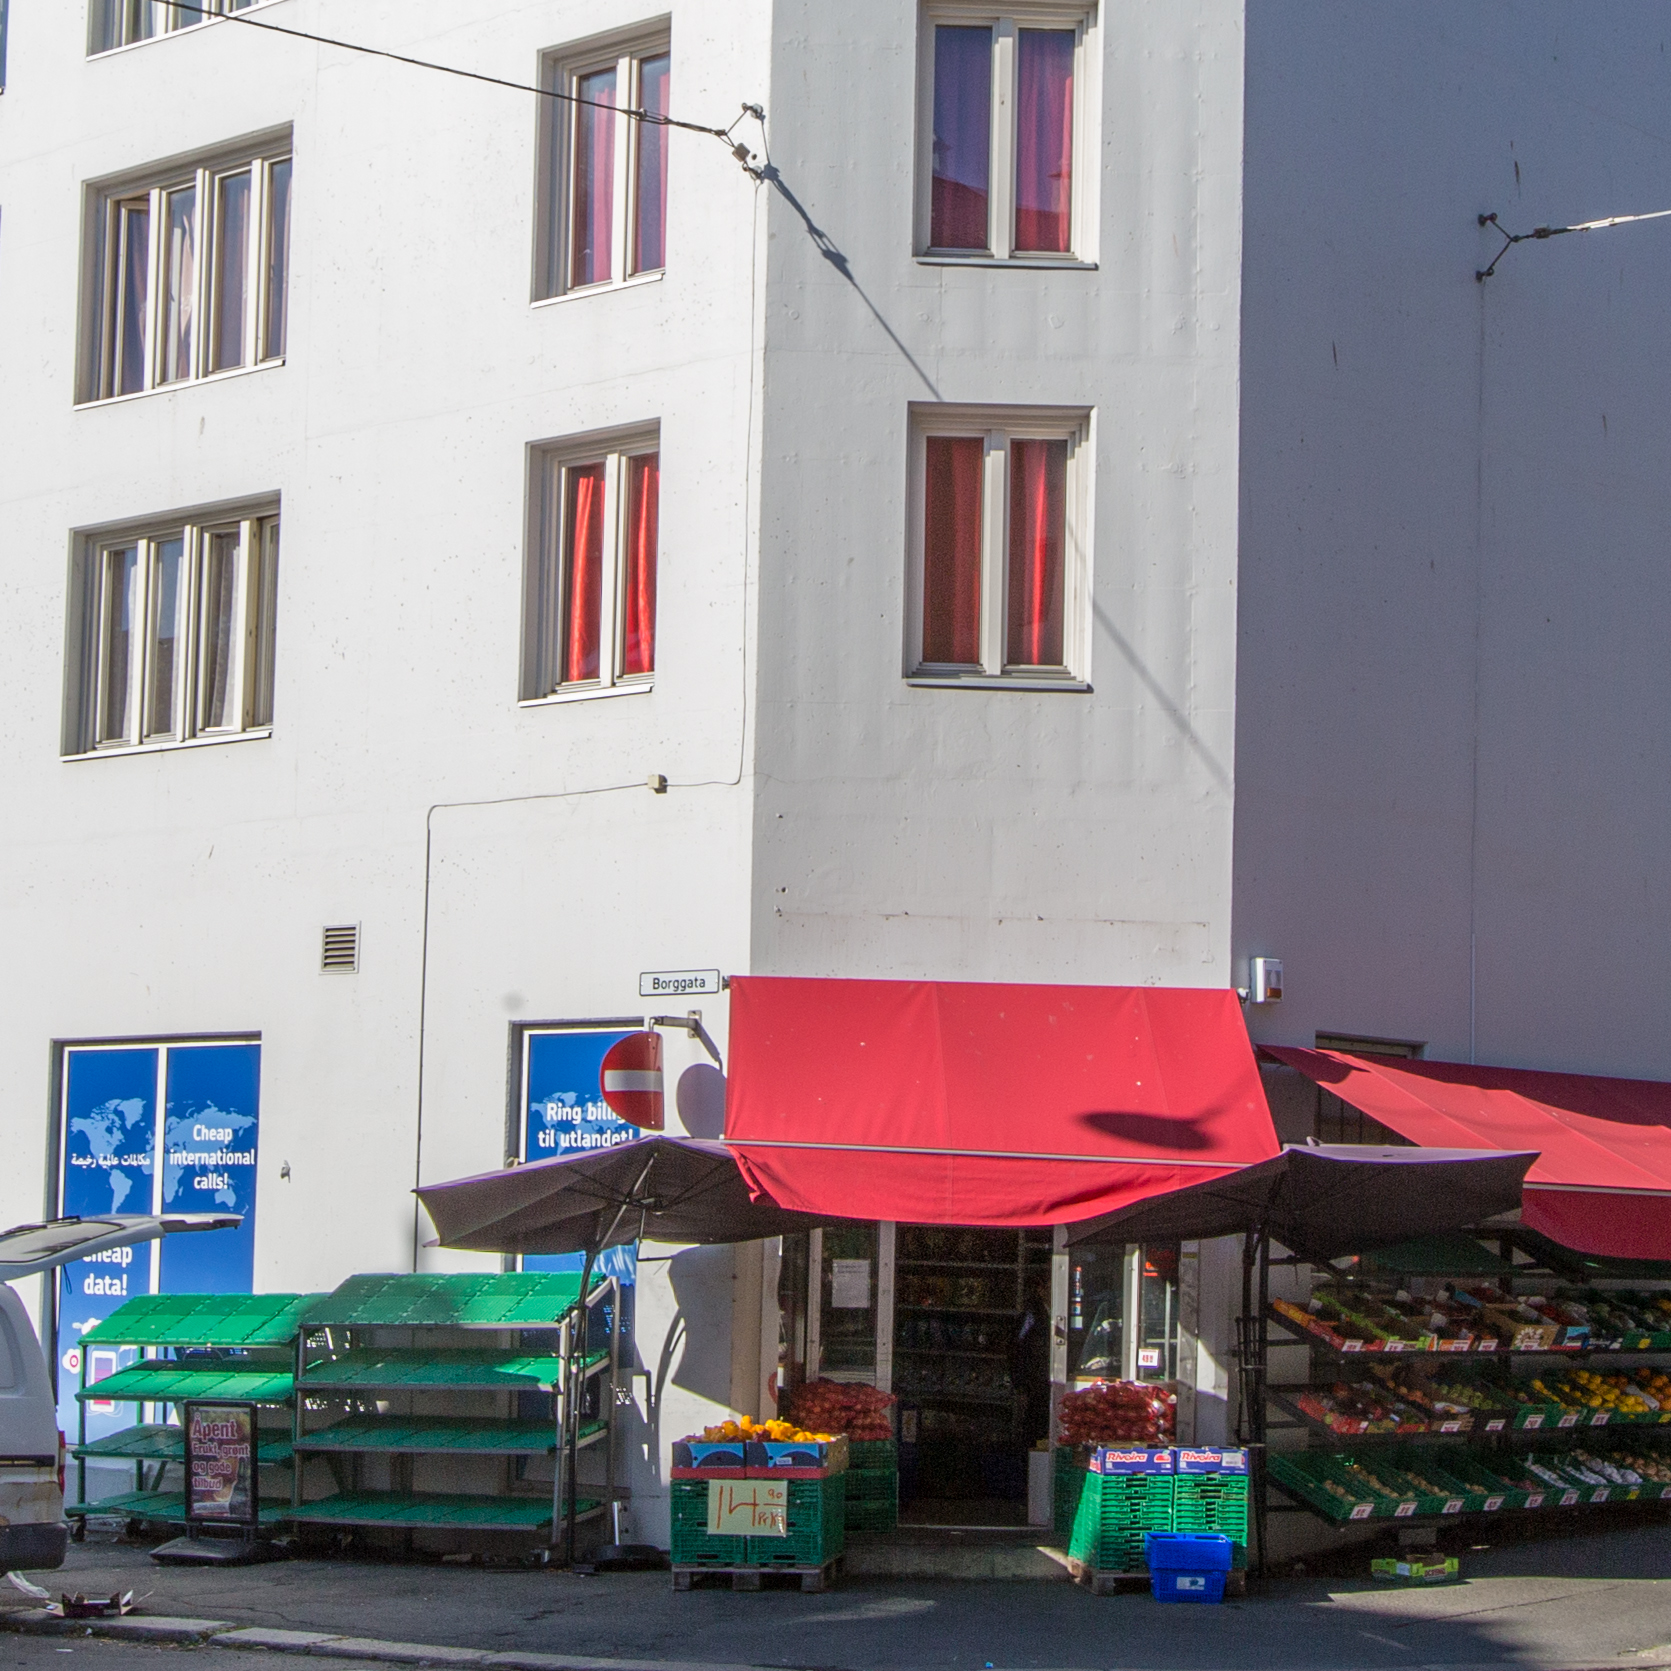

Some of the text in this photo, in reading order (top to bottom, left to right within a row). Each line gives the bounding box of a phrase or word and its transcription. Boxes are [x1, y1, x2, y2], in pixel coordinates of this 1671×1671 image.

[652, 976, 706, 991] Borggata
[546, 1102, 582, 1124] Ring
[192, 1124, 233, 1144] Cheap
[538, 1131, 555, 1147] til
[169, 1149, 255, 1165] international
[193, 1173, 228, 1189] calls!
[84, 1273, 128, 1295] data!
[192, 1412, 237, 1441] Åpent
[222, 1444, 250, 1458] grønt
[1106, 1451, 1148, 1462] Rivoira
[1180, 1450, 1221, 1462] Rivoira
[193, 1461, 231, 1475] og gode
[193, 1476, 223, 1489] tilbud
[716, 1485, 760, 1529] 14
